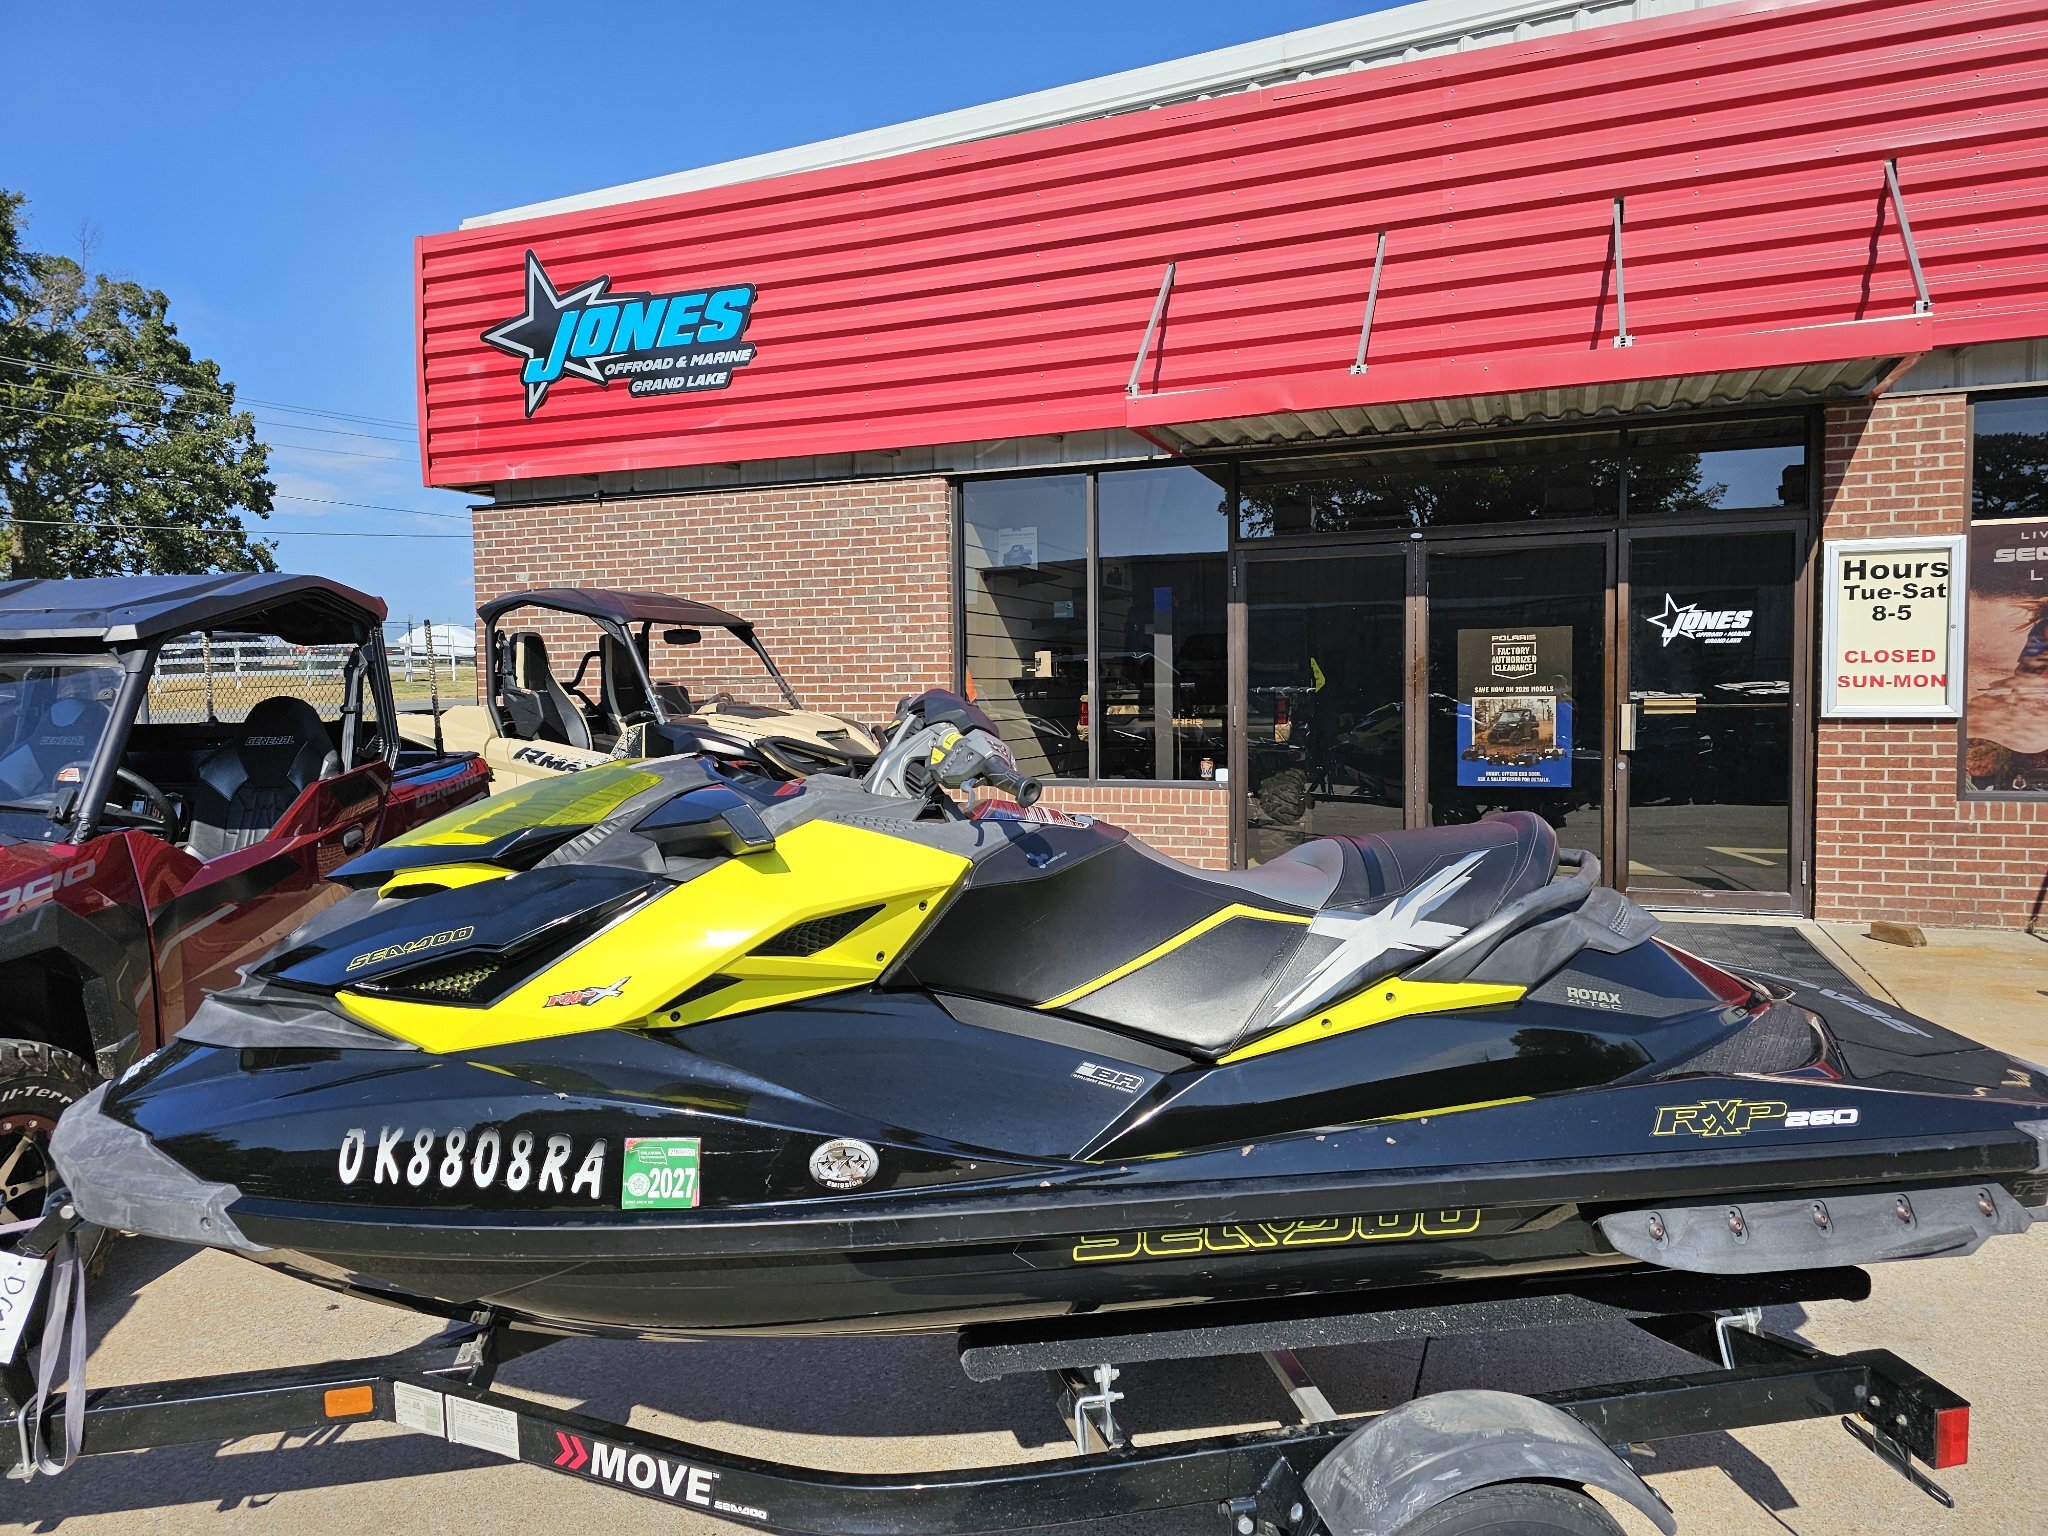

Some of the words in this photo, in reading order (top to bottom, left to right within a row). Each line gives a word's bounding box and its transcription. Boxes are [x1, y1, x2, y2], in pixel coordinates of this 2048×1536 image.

[524, 287, 751, 383] JONES
[604, 357, 672, 376] OFFROAD
[675, 355, 687, 369] &
[689, 349, 753, 367] MARINE
[631, 375, 685, 393] GRAND
[686, 371, 728, 388] LAKE
[1843, 560, 1949, 581] Hours
[1843, 582, 1947, 601] Tue-Sat
[1871, 604, 1912, 621] 8-5
[1661, 610, 1753, 638] JONES
[1491, 655, 1537, 664] AUTHORIZED
[1497, 646, 1531, 656] FACTORY
[1844, 649, 1937, 664] CLOSED
[1494, 664, 1534, 672] CLEARANCE
[1530, 685, 1554, 693] MODELS
[1837, 673, 1947, 688] SUN-MON
[245, 735, 295, 746] GENERAL
[1566, 986, 1621, 1004] ROTAX
[1653, 1100, 1788, 1136] RXP
[1784, 1108, 1860, 1128] 260
[647, 1167, 696, 1198] 2027
[590, 1441, 713, 1506] MOVE
